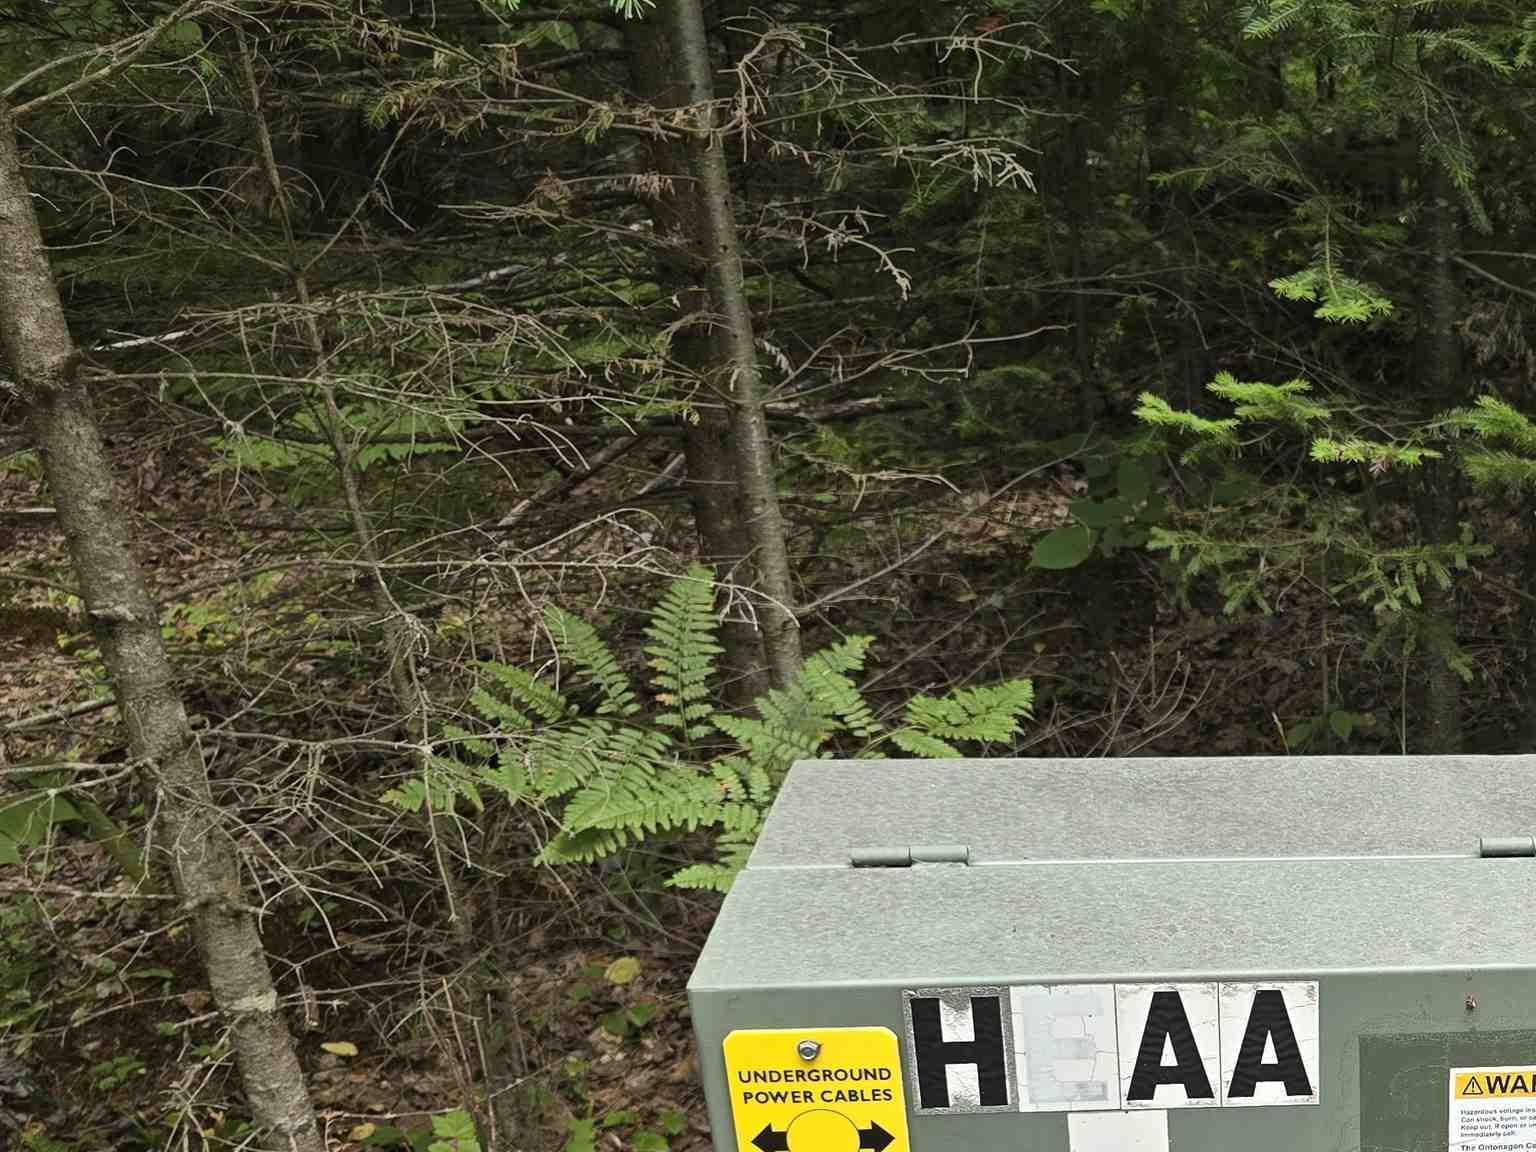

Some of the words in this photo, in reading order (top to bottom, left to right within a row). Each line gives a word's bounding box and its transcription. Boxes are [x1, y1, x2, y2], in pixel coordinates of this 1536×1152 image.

[738, 1067, 892, 1084] UNDERGROUND
[743, 1090, 816, 1104] POWER
[820, 1088, 893, 1103] CABLES
[1478, 1143, 1524, 1152] Ontonagon
